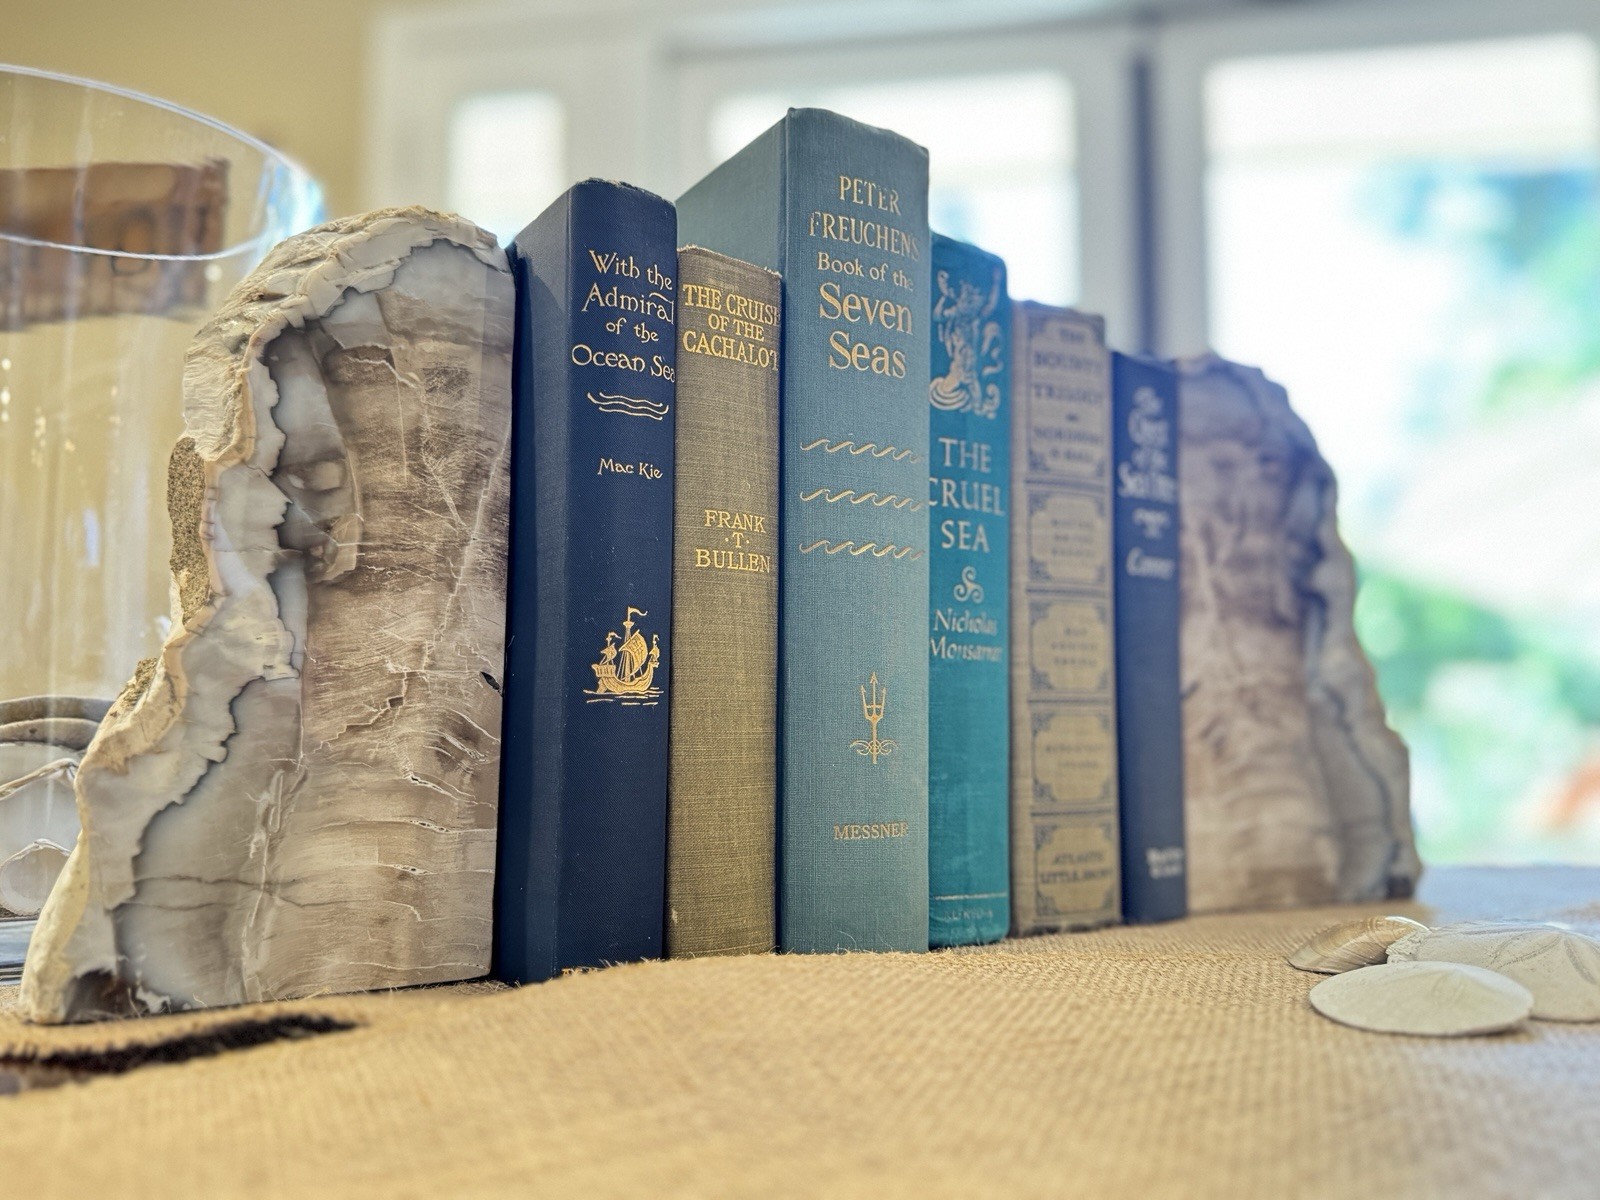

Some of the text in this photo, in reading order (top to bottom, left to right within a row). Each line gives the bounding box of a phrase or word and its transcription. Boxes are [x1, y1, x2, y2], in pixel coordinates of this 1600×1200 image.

[839, 175, 901, 216] PETER
[588, 249, 673, 291] With the
[817, 251, 914, 292] Book of the
[581, 282, 675, 326] Admiral
[682, 283, 781, 328] THE CRUISE
[818, 282, 914, 336] Seven
[605, 317, 660, 344] of the
[708, 312, 765, 343] OF THE
[571, 343, 646, 373] Ocean
[682, 329, 779, 372] CACHALOT
[828, 329, 907, 380] Seas
[597, 457, 664, 480] Mac Kie
[938, 436, 992, 474] THE
[929, 476, 1006, 516] CRUEL
[704, 509, 767, 534] FRANK
[940, 519, 991, 554] SEA
[695, 548, 771, 574] BULLEN
[833, 820, 909, 841] MESSNER
